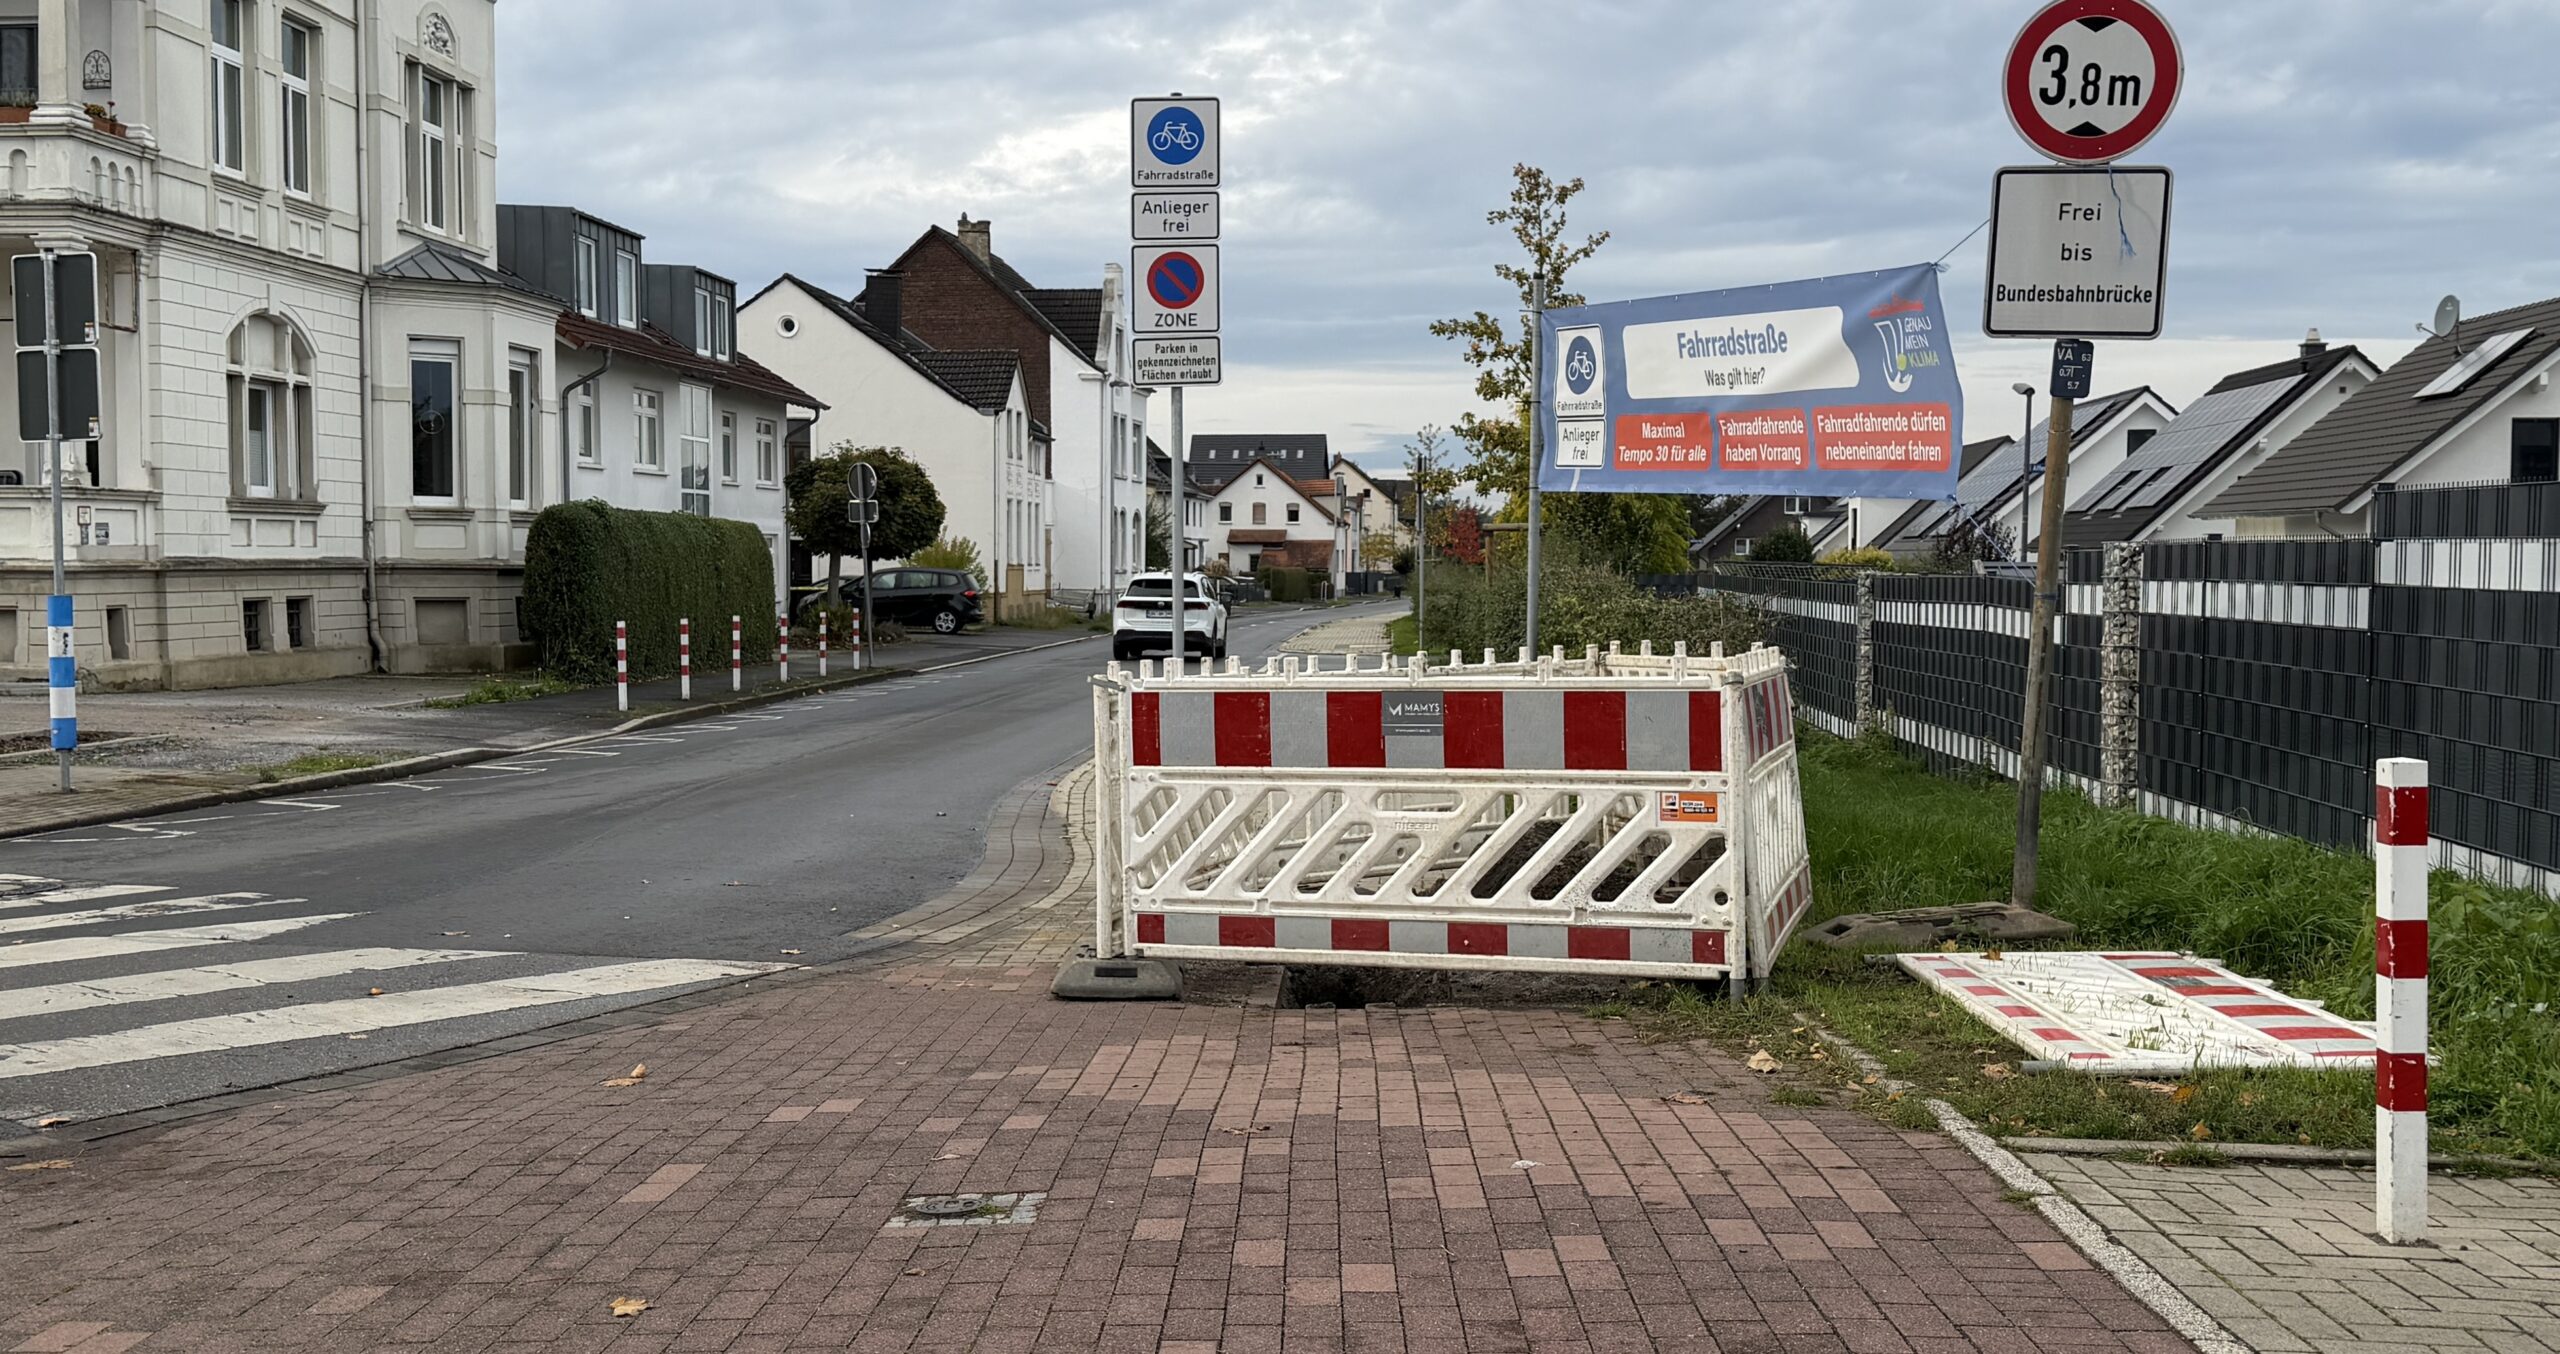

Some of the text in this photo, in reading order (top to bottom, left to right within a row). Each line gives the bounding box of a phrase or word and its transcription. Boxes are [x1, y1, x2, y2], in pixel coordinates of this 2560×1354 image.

[1137, 169, 1214, 180] Fahrradstraße
[1142, 200, 1209, 217] Anlieger
[2058, 202, 2101, 221] Frei
[1163, 218, 1190, 232] frei
[2061, 243, 2092, 261] bis
[1996, 284, 2153, 303] Bundesbahnbrücke
[1154, 312, 1198, 327] ZONE
[1904, 316, 1932, 332] GENAU
[1155, 343, 1198, 354] Parken in
[1677, 323, 1788, 359] Fahrradstraße
[1905, 334, 1929, 350] MEIN
[1137, 355, 1217, 370] gekennzeichneten
[1908, 350, 1940, 368] KLIMA
[2057, 347, 2073, 361] VA
[1142, 367, 1212, 380] Flächen erlaubt
[1704, 366, 1766, 390] Was gilt hier?
[1557, 400, 1602, 411] Fahrradstraße
[1641, 421, 1685, 439] Maximal
[1719, 415, 1804, 436] Fahrradfahrende
[1817, 410, 1945, 433] Fahrradfahrende dürfen
[1562, 427, 1600, 445] Anlieger
[1572, 446, 1589, 460] frei
[1618, 445, 1707, 465] Tempo 30 für alle
[1726, 443, 1801, 465] haben Vorrang
[1826, 440, 1941, 461] nebeneinander fahren
[1404, 703, 1440, 712] MAMYS
